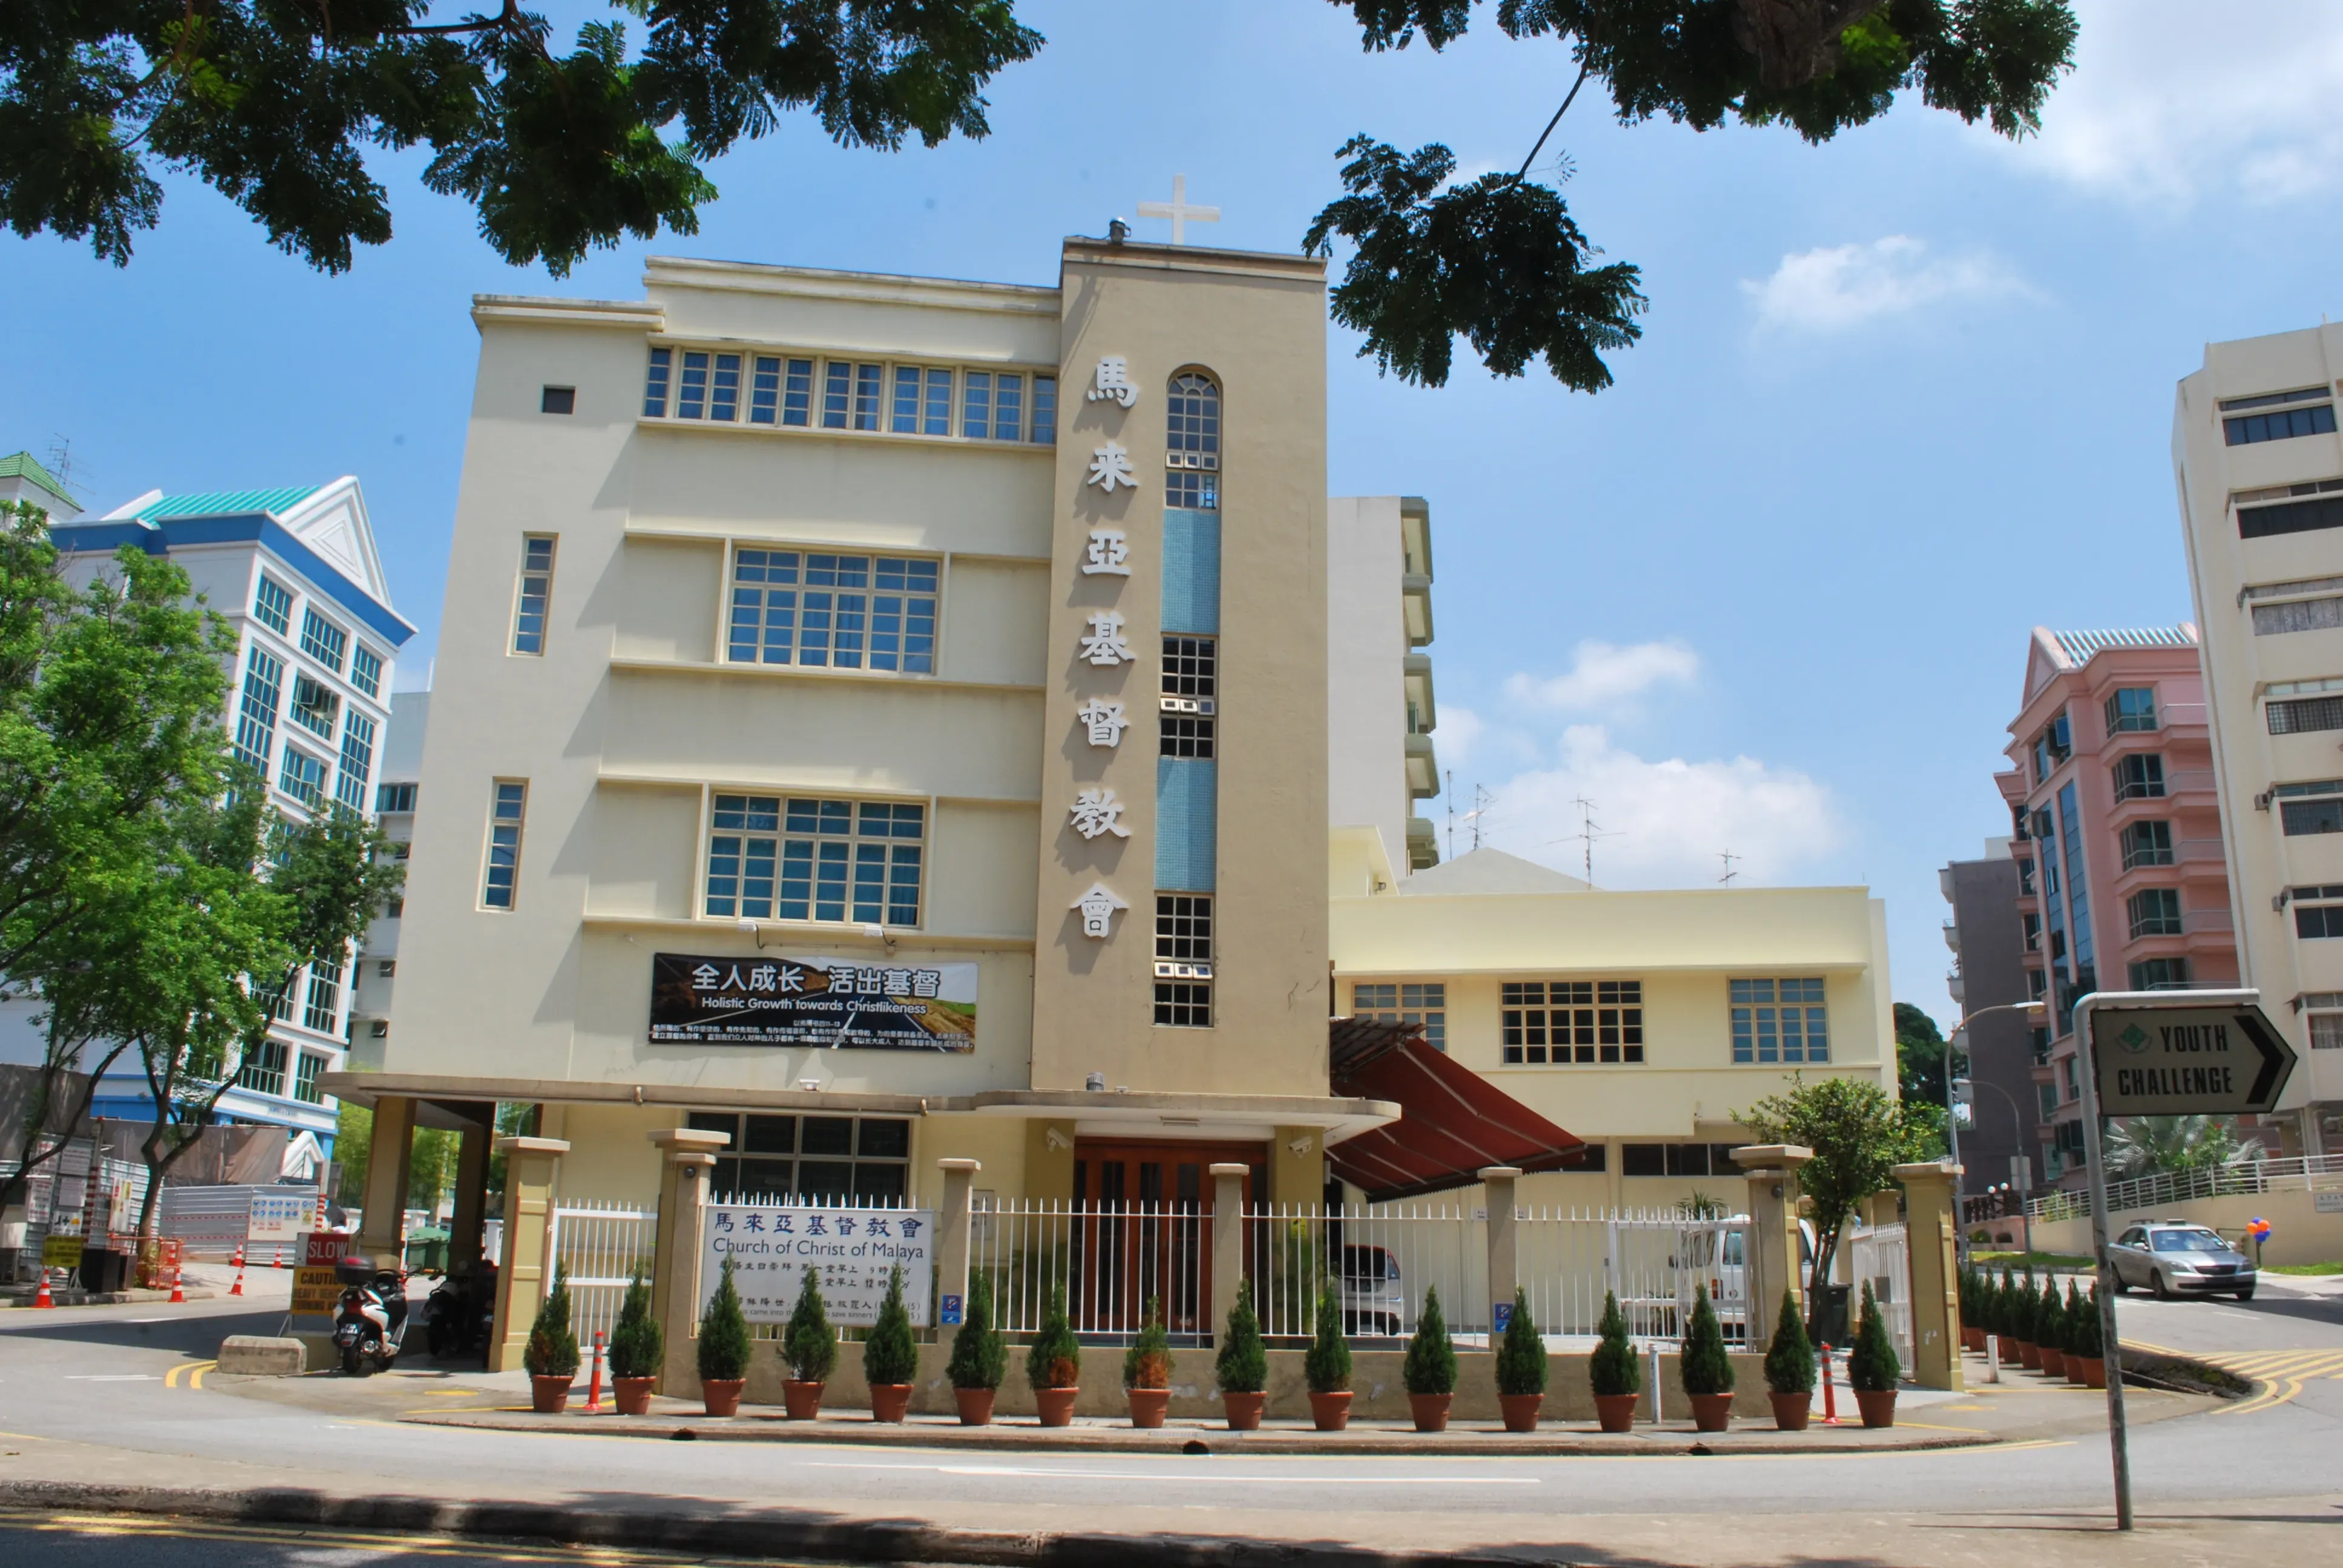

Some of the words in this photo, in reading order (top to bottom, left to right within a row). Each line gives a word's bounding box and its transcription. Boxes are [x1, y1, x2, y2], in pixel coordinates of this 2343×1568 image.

[692, 963, 805, 992] 全人成长
[827, 967, 939, 997] 活出基督
[701, 997, 745, 1008] Holistic
[748, 999, 792, 1010] Growth
[796, 999, 843, 1011] towards
[847, 1000, 927, 1014] Christlikeness
[2159, 1025, 2229, 1053] YOUTH
[2118, 1067, 2233, 1096] CHALLENGE
[715, 1212, 923, 1238] 馬來亞基督教會
[309, 1241, 348, 1258] SLOW
[713, 1237, 770, 1254] Church
[776, 1240, 793, 1254] of
[797, 1240, 845, 1256] Christ
[851, 1241, 868, 1256] of
[872, 1242, 923, 1262] Malaya
